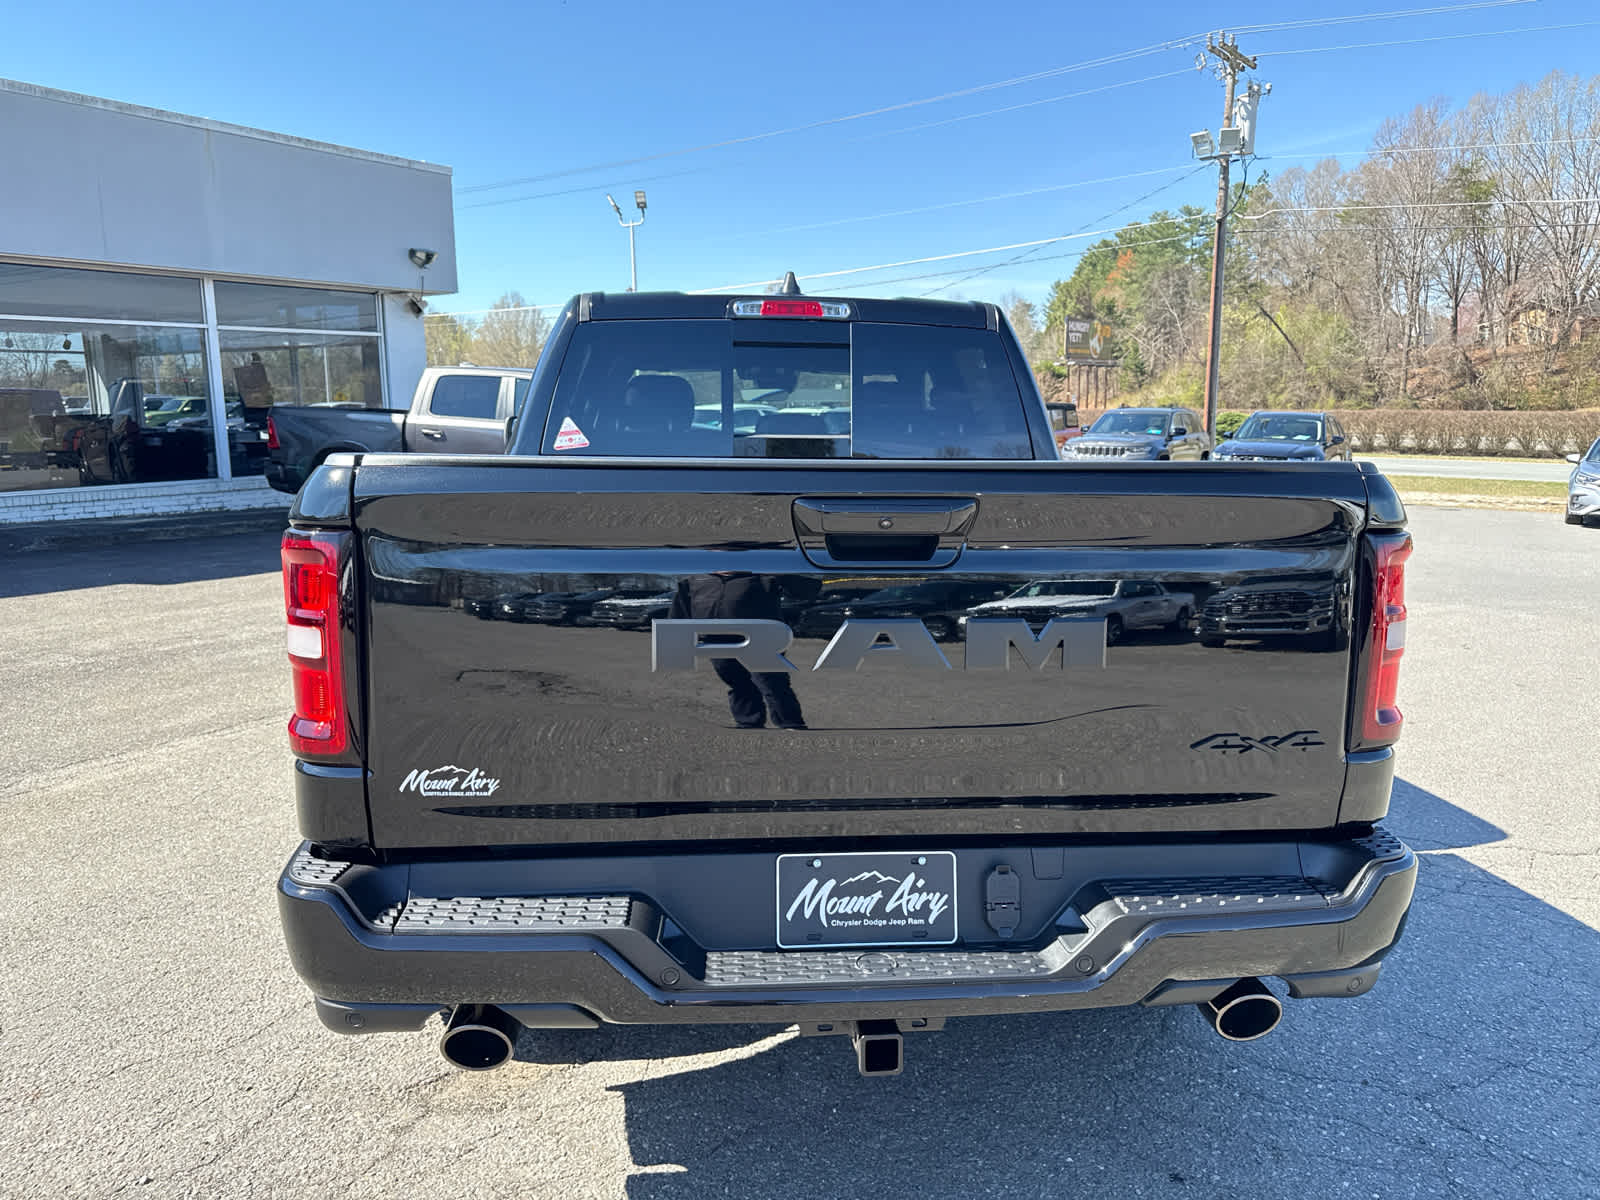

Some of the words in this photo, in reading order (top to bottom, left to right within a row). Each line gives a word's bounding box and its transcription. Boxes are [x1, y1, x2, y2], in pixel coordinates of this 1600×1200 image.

[651, 618, 1108, 672] RAM
[399, 768, 459, 797] Mount
[460, 767, 500, 796] Airy
[786, 878, 883, 928] Mount
[885, 871, 949, 925] Airy
[831, 919, 861, 927] Chrysler
[863, 918, 887, 927] Dodge
[889, 917, 906, 926] Jeep
[908, 917, 925, 925] Ram
